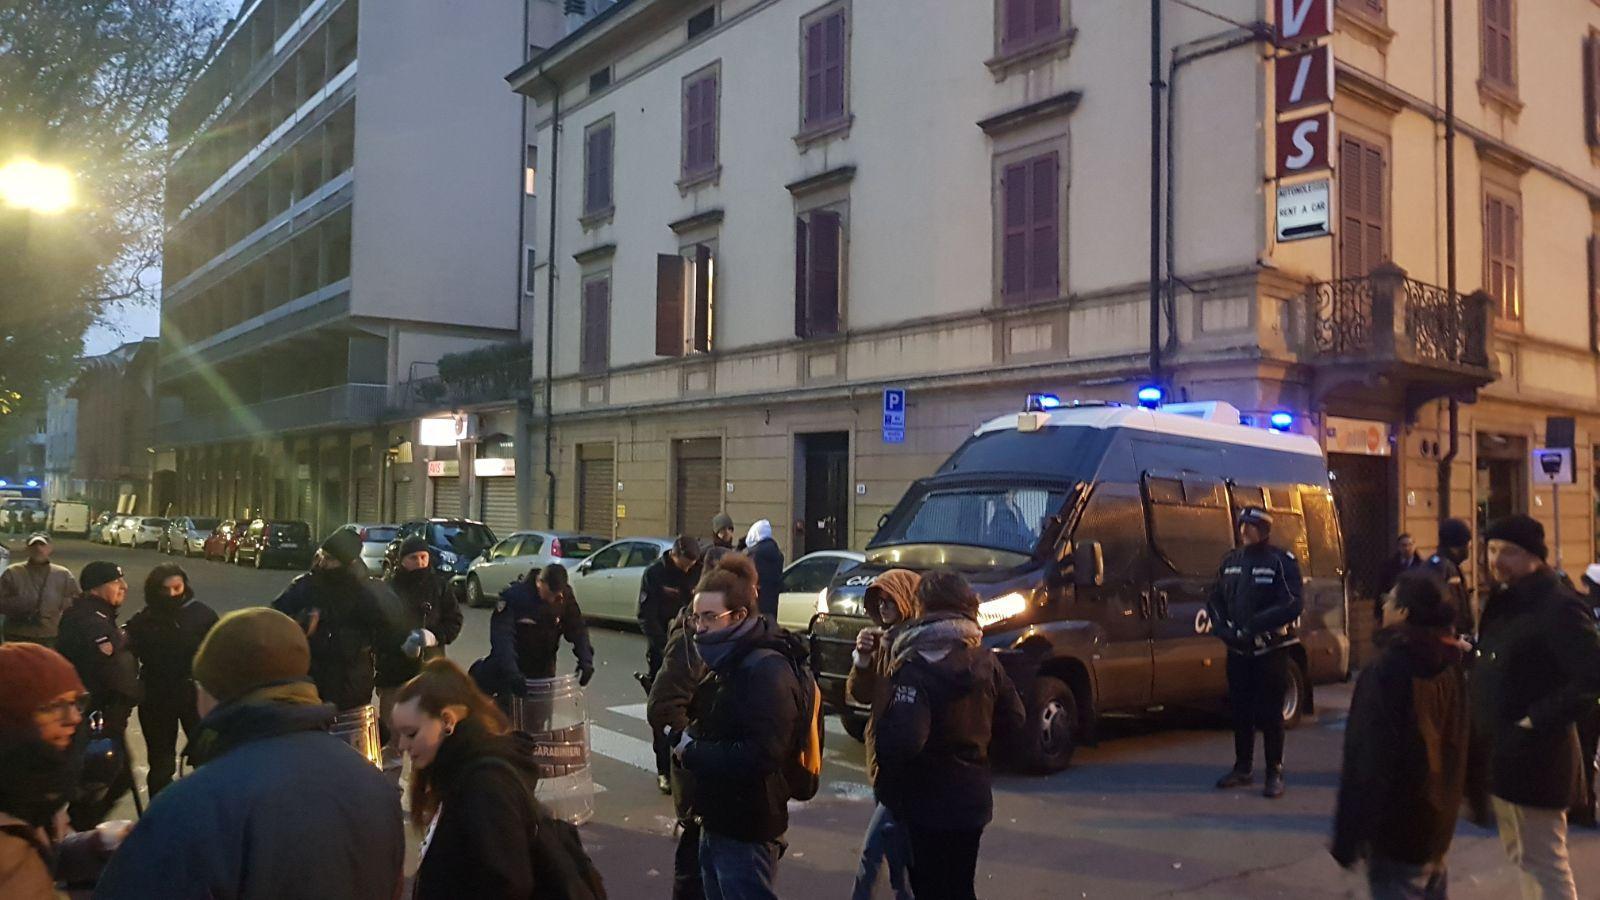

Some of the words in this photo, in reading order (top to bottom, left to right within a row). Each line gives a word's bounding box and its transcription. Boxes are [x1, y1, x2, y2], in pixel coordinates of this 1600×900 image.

[1280, 205, 1296, 217] RENT
[1302, 205, 1307, 214] A
[1311, 200, 1325, 211] CAR
[889, 392, 900, 409] P
